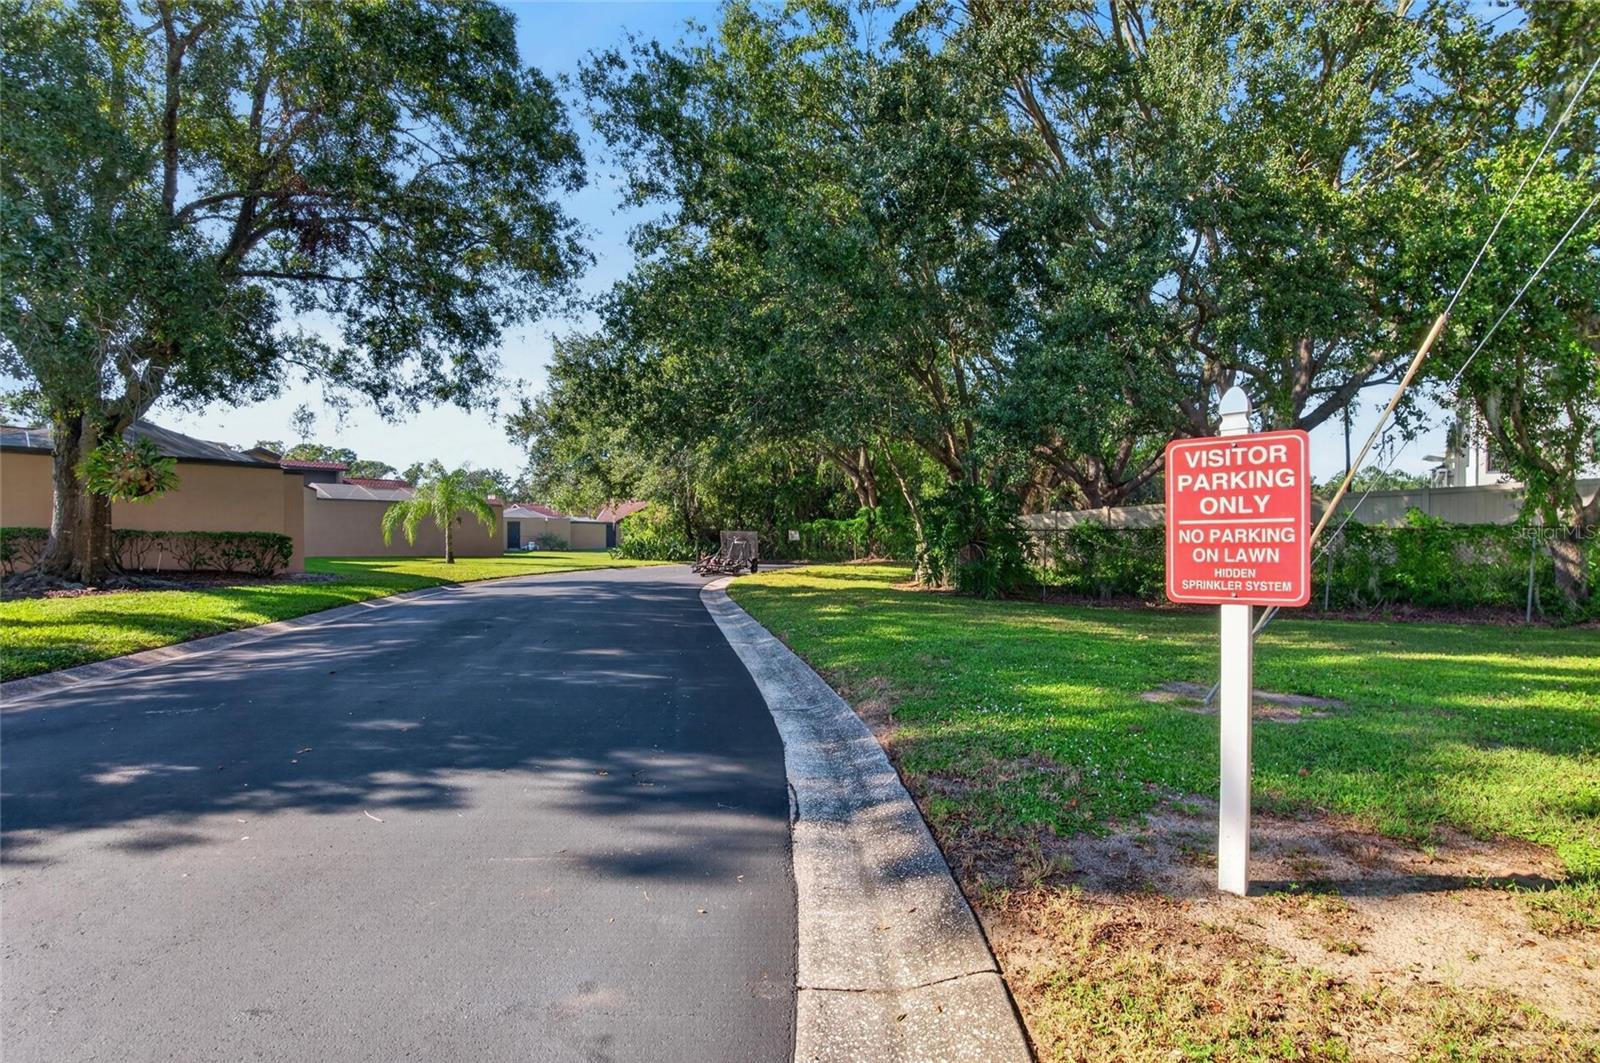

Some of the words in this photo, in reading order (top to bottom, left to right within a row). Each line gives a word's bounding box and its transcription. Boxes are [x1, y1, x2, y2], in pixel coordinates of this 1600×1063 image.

[1185, 445, 1287, 468] VISITOR
[1178, 469, 1295, 492] PARKING
[1200, 495, 1270, 514] ONLY
[1179, 529, 1204, 543] NO
[1210, 528, 1295, 543] PARKING
[1193, 549, 1218, 562] ON
[1225, 548, 1279, 563] LAWN
[1214, 569, 1255, 578] HIDDEN
[1182, 580, 1241, 590] SPRINKLER
[1246, 581, 1291, 591] SYSTEM
